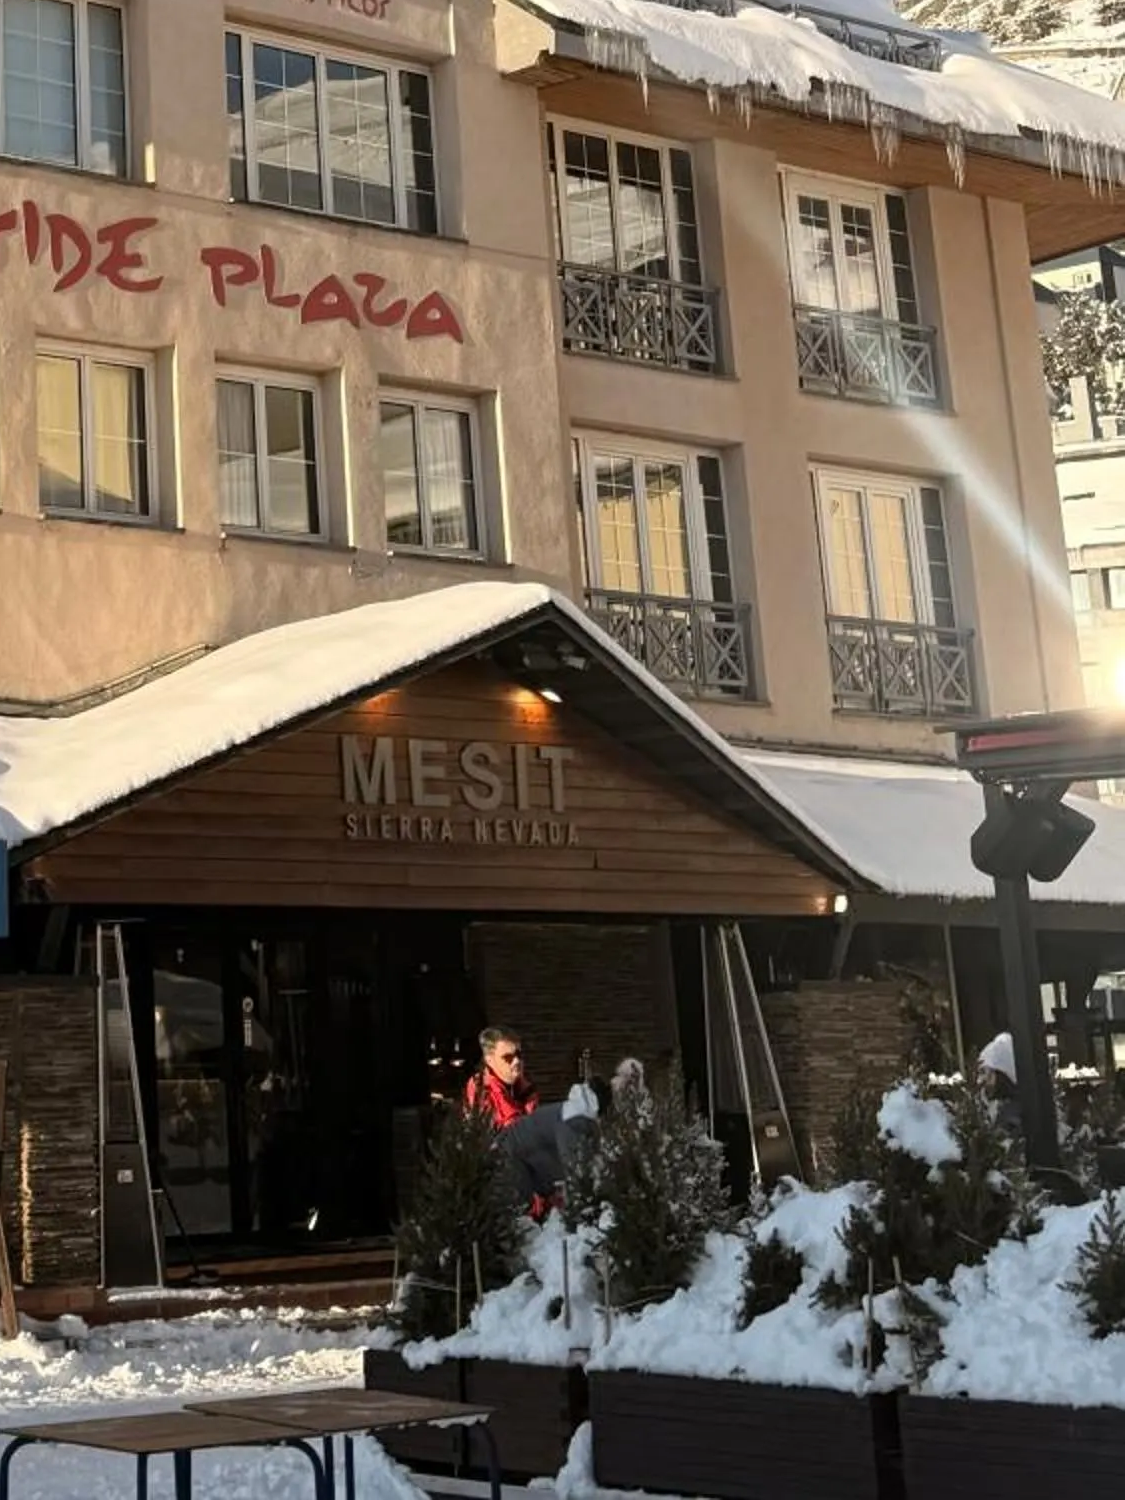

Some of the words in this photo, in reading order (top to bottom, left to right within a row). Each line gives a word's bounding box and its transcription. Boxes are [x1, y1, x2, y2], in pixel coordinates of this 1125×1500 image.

[199, 243, 465, 344] PLAZA
[341, 733, 576, 812] MESIT
[346, 813, 454, 841] SIERRA
[474, 817, 580, 845] NEVADA
